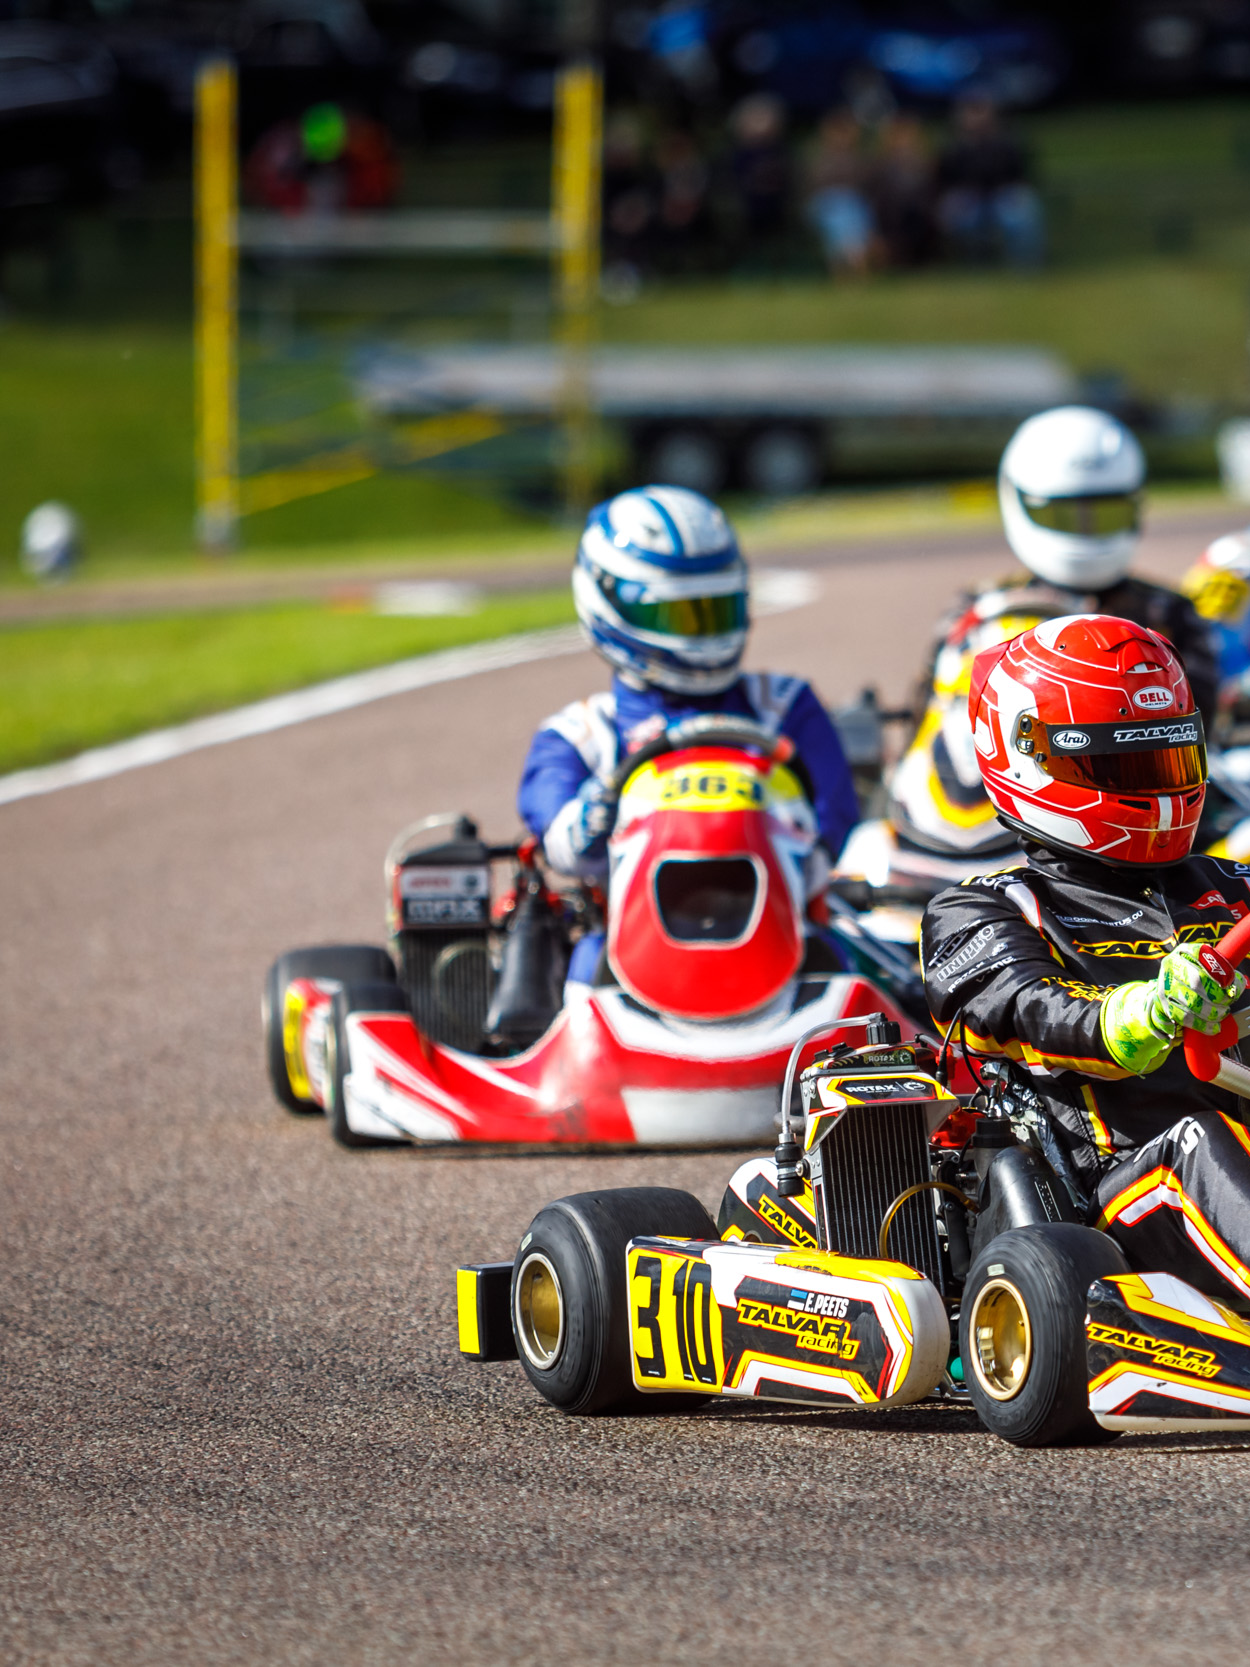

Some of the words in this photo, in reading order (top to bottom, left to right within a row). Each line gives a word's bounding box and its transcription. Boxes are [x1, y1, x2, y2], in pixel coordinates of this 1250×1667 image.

[1139, 692, 1169, 703] BELL
[1056, 732, 1084, 744] Arai
[1114, 723, 1195, 742] TALVAR
[1169, 731, 1198, 742] racing
[936, 924, 994, 982] UNIPRO
[846, 1084, 897, 1093] ROTAX
[760, 1195, 817, 1249] TALVA
[804, 1292, 850, 1319] E.PEETS
[632, 1255, 718, 1386] 310
[740, 1302, 848, 1338] TALVAR
[800, 1335, 855, 1356] racing
[1091, 1325, 1212, 1363] TALVAR
[1157, 1355, 1216, 1376] racing
